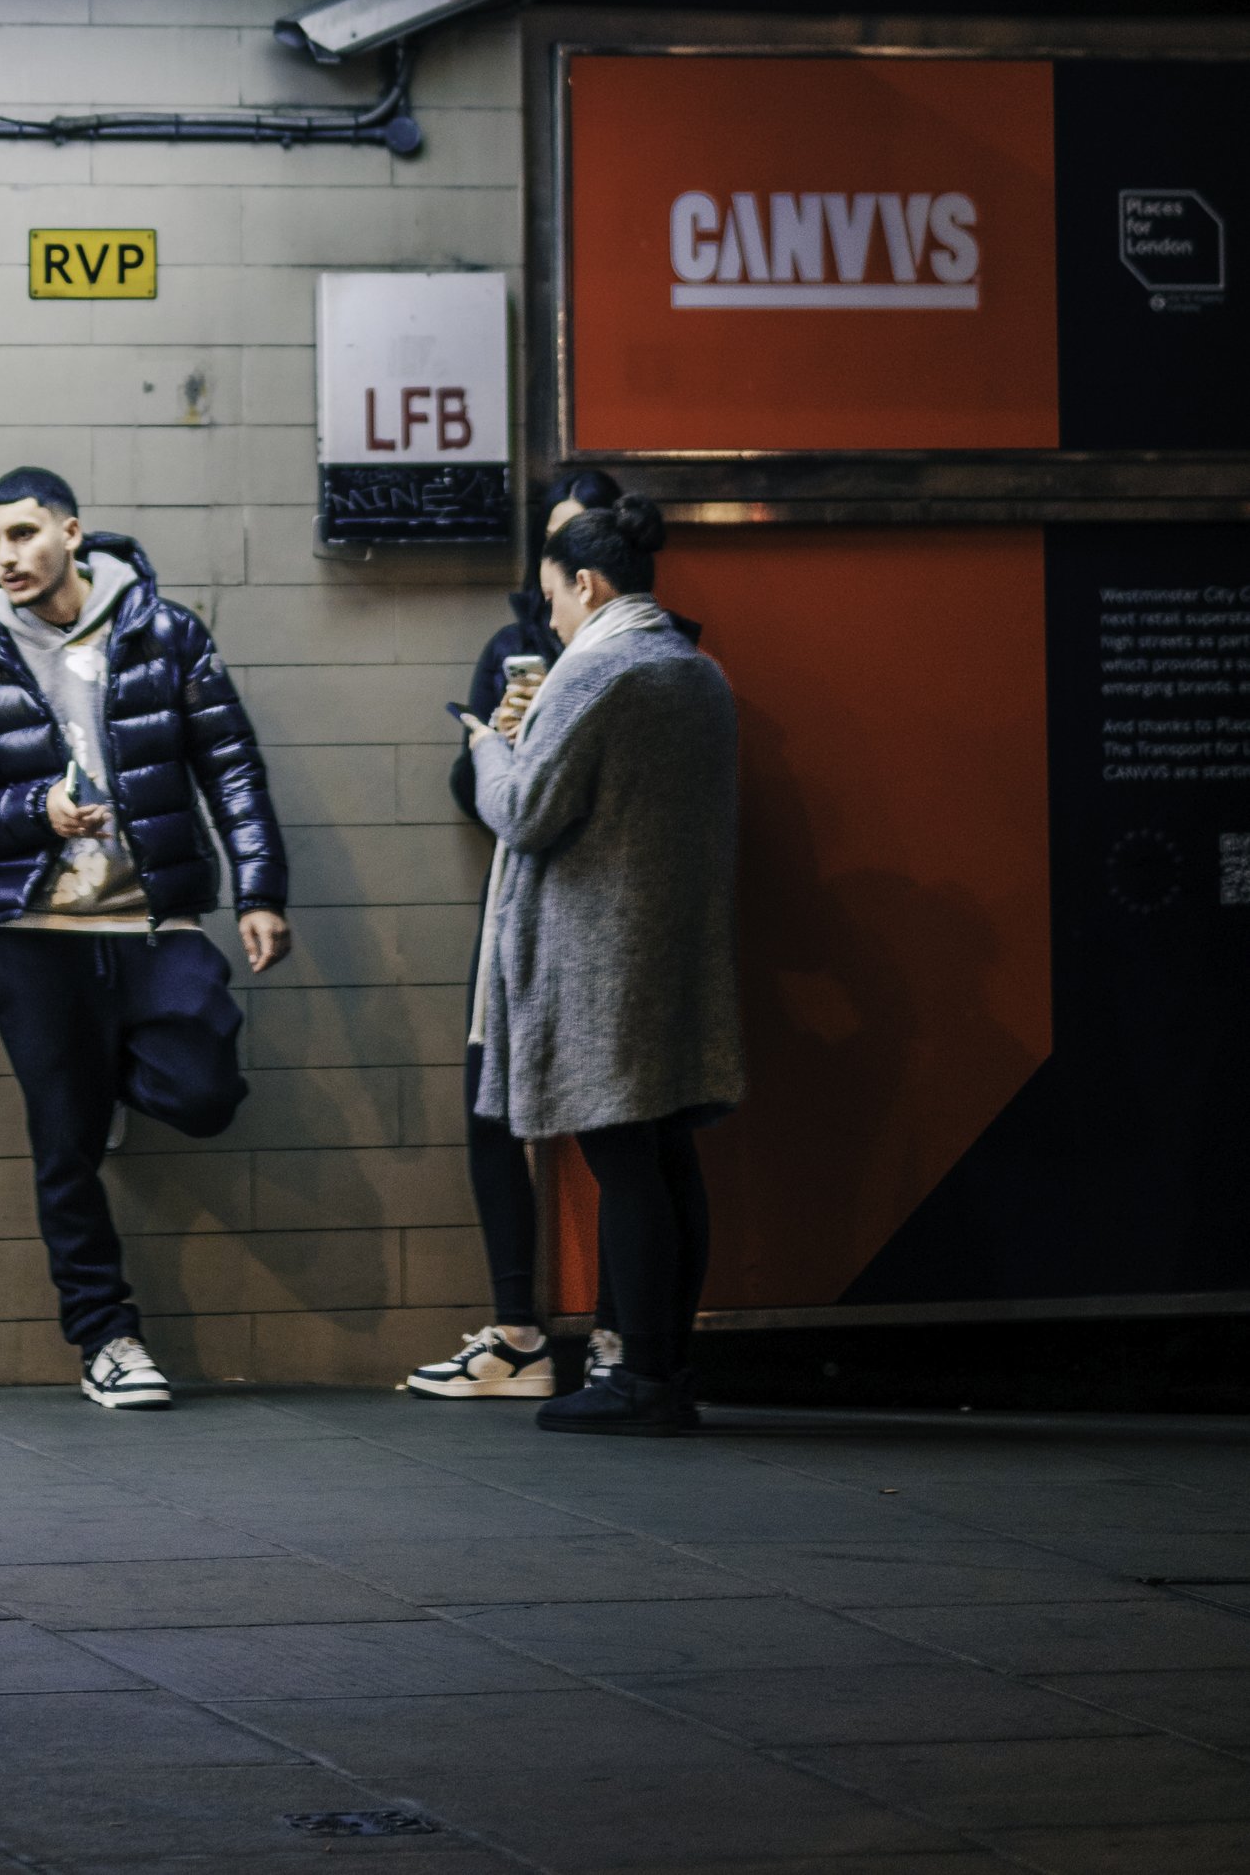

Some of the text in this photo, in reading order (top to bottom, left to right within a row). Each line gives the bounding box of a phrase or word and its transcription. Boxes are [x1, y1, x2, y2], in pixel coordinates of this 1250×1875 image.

[1126, 197, 1183, 216] Places
[1126, 218, 1152, 236] for
[1127, 238, 1193, 255] London
[44, 243, 145, 285] RVP
[366, 386, 473, 452] LFB
[1100, 589, 1198, 603] Westminster
[1203, 586, 1236, 605] City
[1140, 611, 1181, 625] retail
[1101, 682, 1174, 699] emerging
[1138, 719, 1191, 734] thanks
[1102, 741, 1132, 757] The
[1136, 741, 1212, 759] Transport
